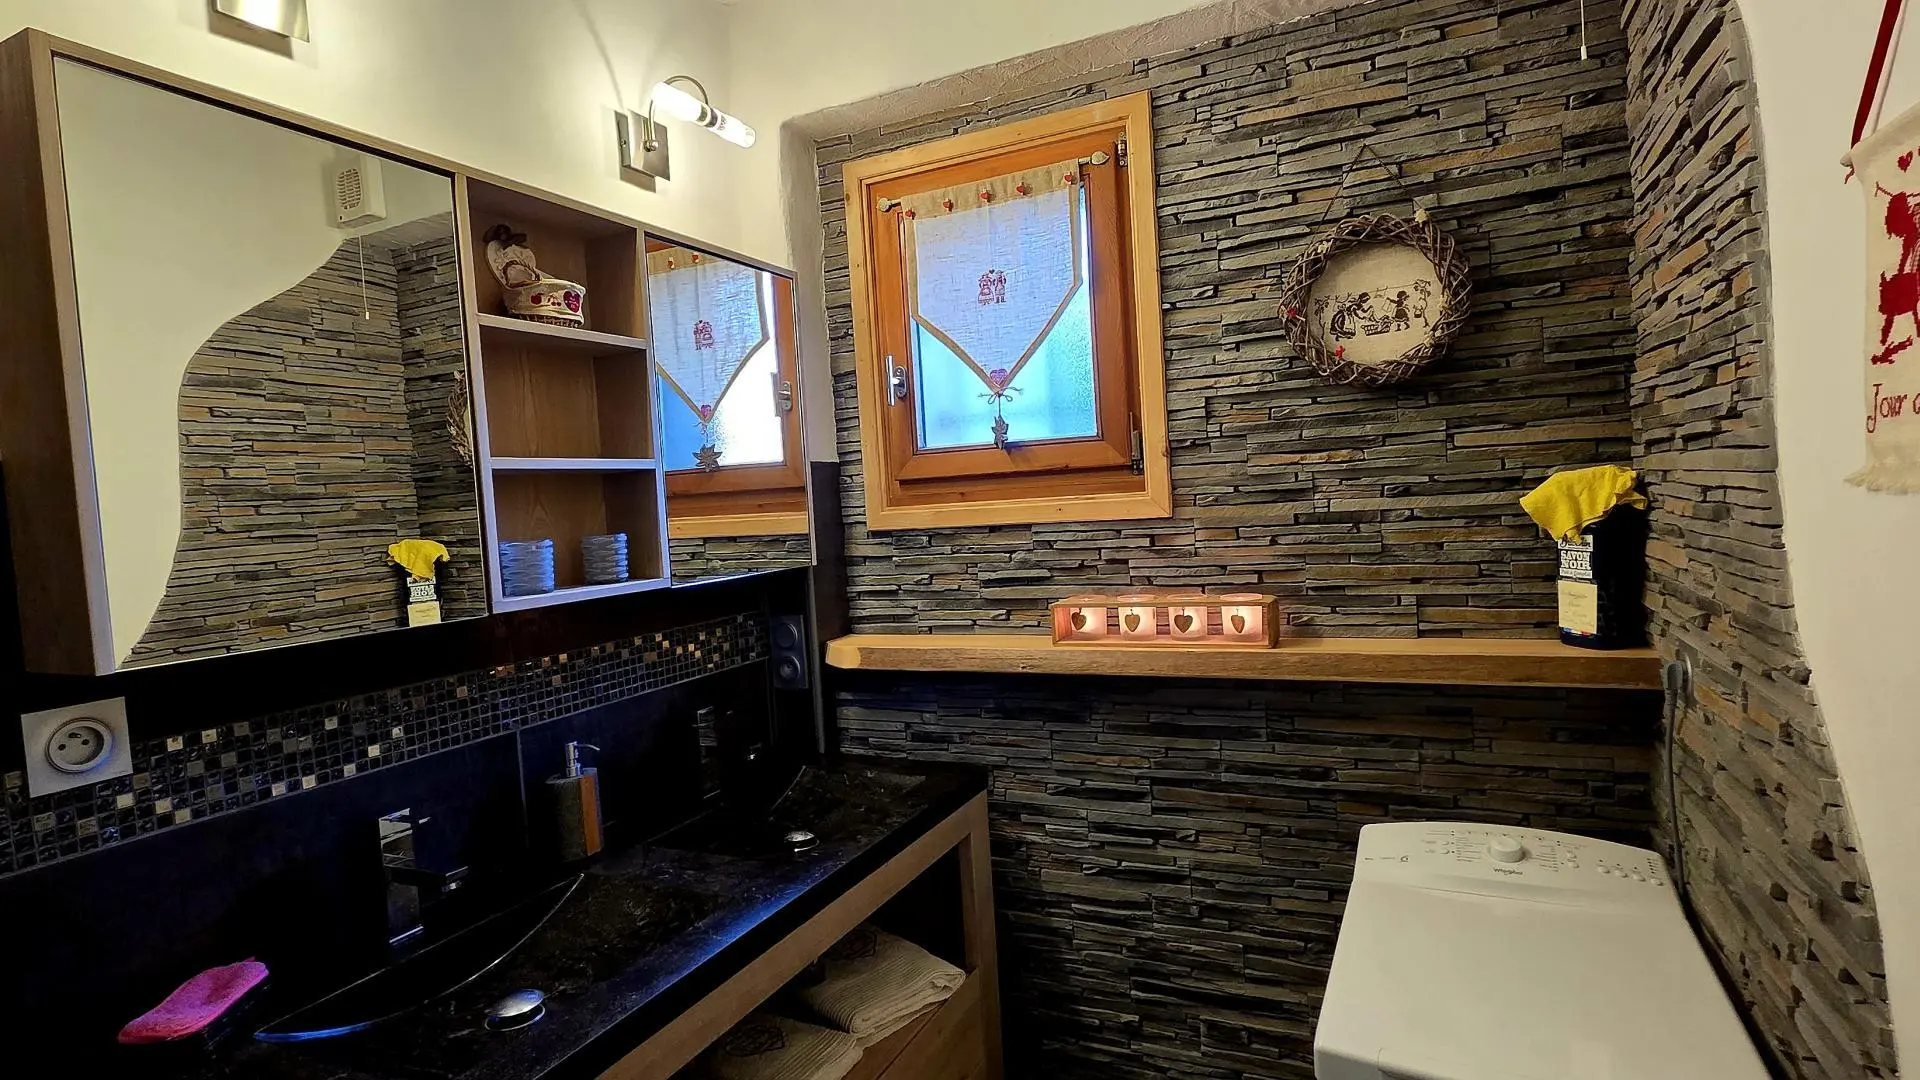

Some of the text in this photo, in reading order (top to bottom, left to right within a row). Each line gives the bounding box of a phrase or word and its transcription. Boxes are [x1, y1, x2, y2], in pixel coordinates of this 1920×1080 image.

[1866, 383, 1908, 434] Jour
[1560, 550, 1591, 561] SAVON
[1560, 560, 1592, 570] NOIR
